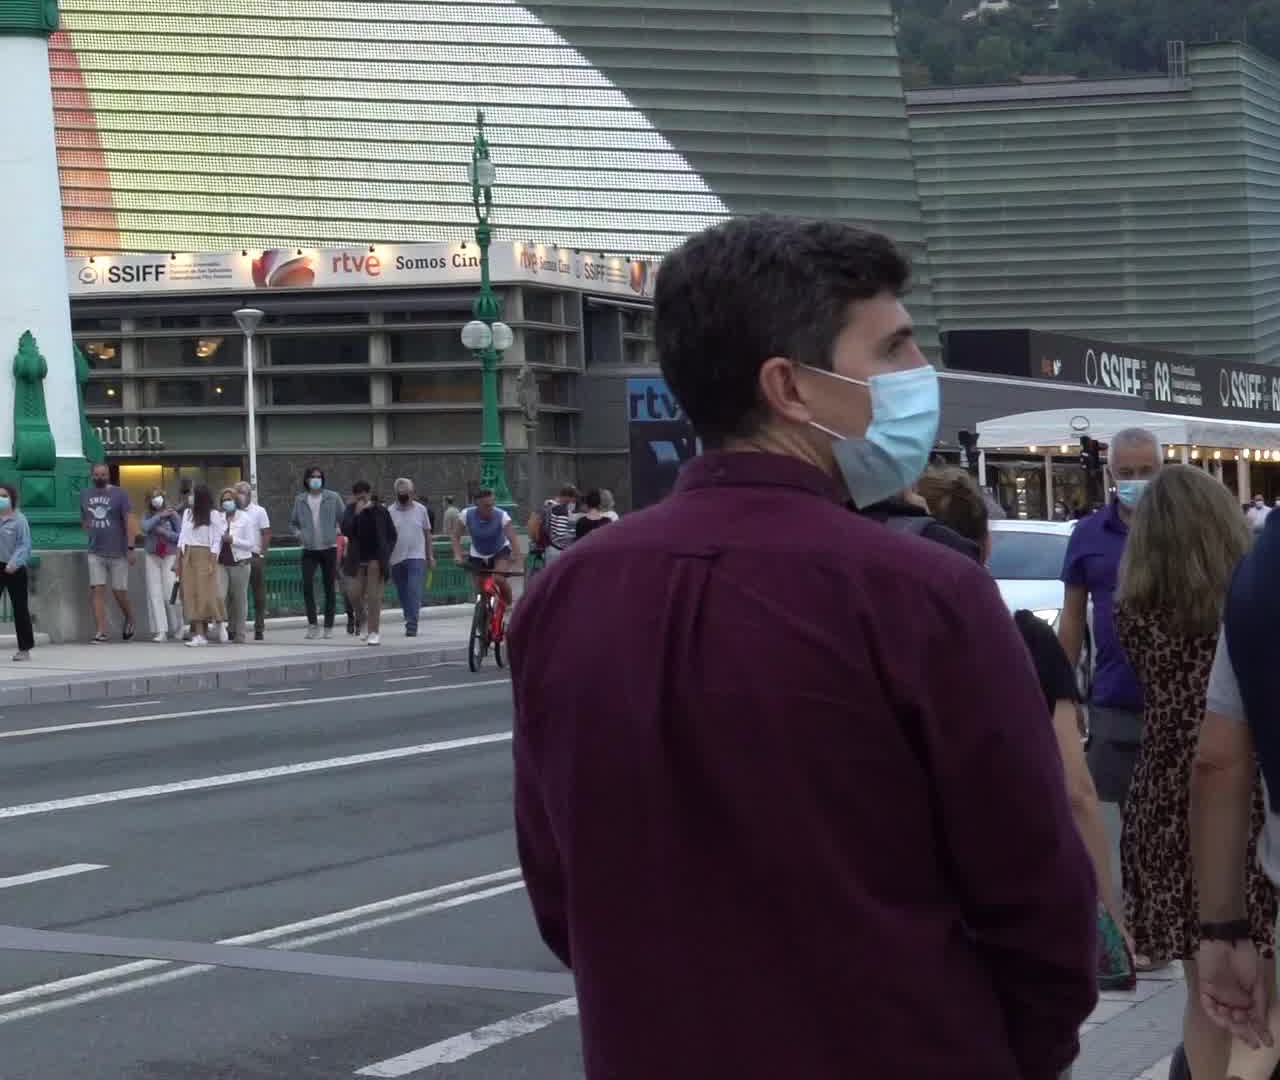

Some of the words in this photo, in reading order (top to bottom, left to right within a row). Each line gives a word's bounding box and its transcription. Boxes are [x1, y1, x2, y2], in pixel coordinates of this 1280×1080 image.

[108, 264, 166, 283] SSIFF
[332, 252, 381, 277] rtve
[396, 256, 446, 270] Somos
[1101, 352, 1140, 396] SSIFF
[1154, 361, 1171, 401] 68
[1231, 370, 1262, 409] SSIFF
[1271, 376, 1280, 412] 6
[630, 385, 678, 419] rtv
